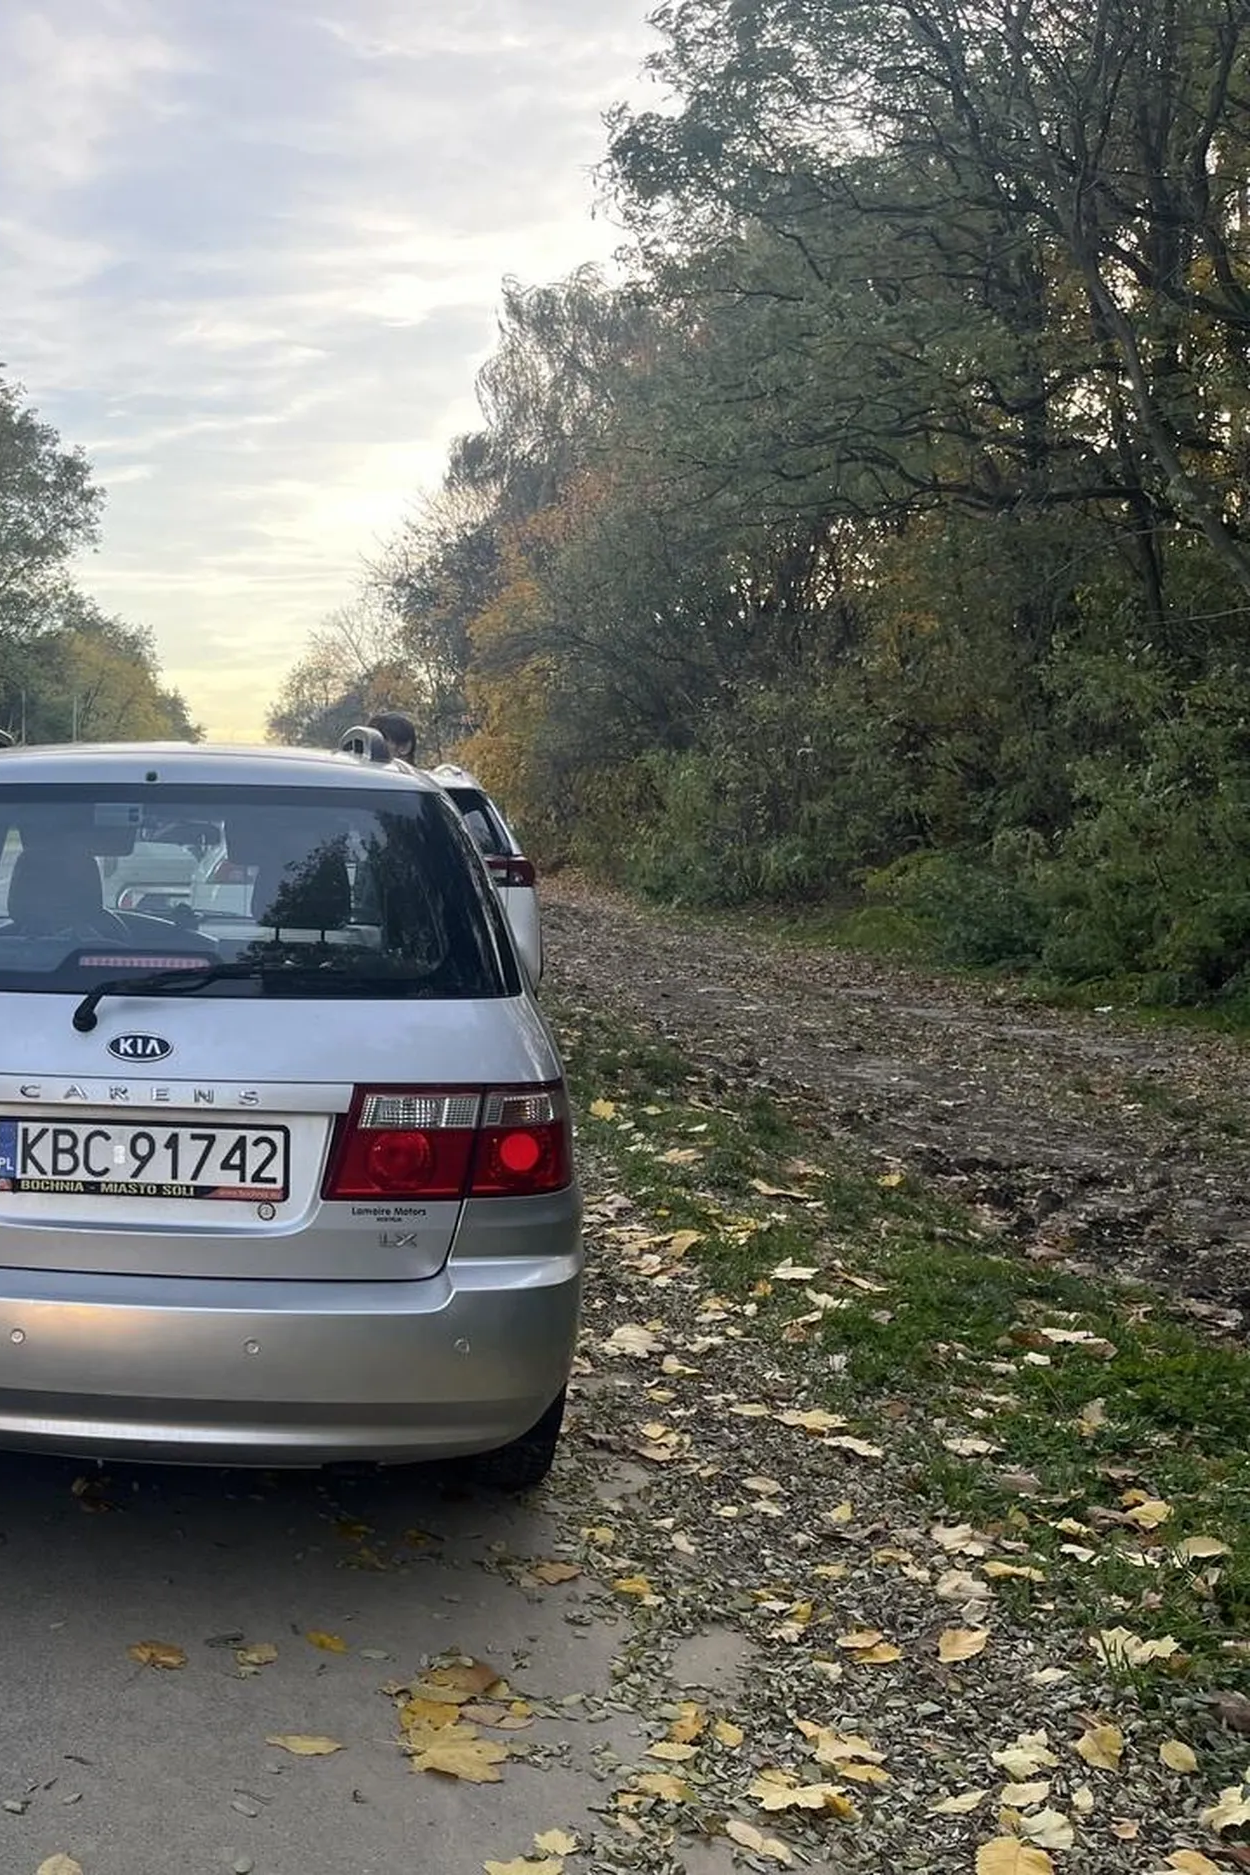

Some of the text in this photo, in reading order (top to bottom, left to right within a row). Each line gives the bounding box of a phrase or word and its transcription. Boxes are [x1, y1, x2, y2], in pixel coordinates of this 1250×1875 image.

[118, 1038, 161, 1055] KIA
[20, 1084, 259, 1105] CARENS
[20, 1128, 278, 1184] KBC 91742
[20, 1180, 84, 1192] BOCHNIA
[100, 1183, 157, 1195] MIASTO
[162, 1184, 194, 1197] SOLI
[394, 1207, 426, 1216] Motors
[379, 1232, 417, 1248] LX
